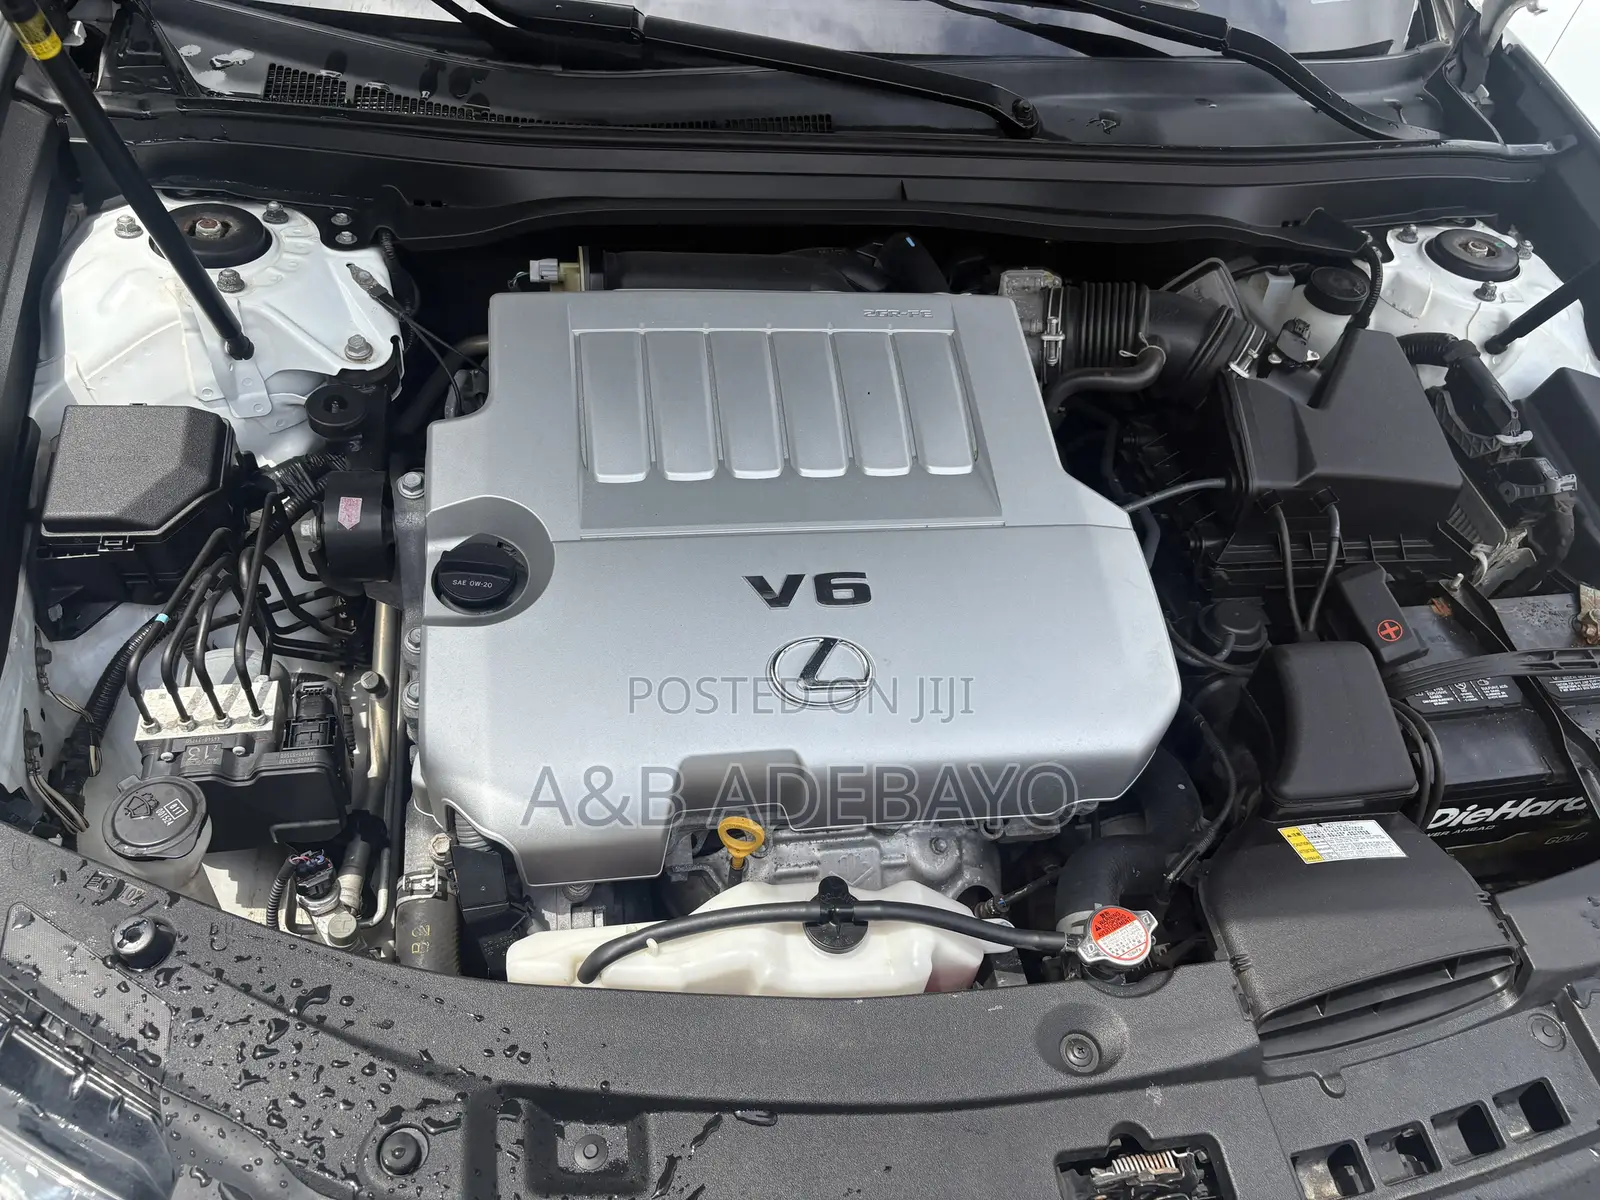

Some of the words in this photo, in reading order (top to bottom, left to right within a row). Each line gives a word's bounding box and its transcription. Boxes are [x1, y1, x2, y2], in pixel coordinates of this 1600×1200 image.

[863, 309, 934, 318] 2GR-FE
[469, 580, 493, 589] 0W-20
[742, 571, 872, 609] V6
[1451, 825, 1497, 835] AHEAD
[1544, 832, 1588, 845] GOLD
